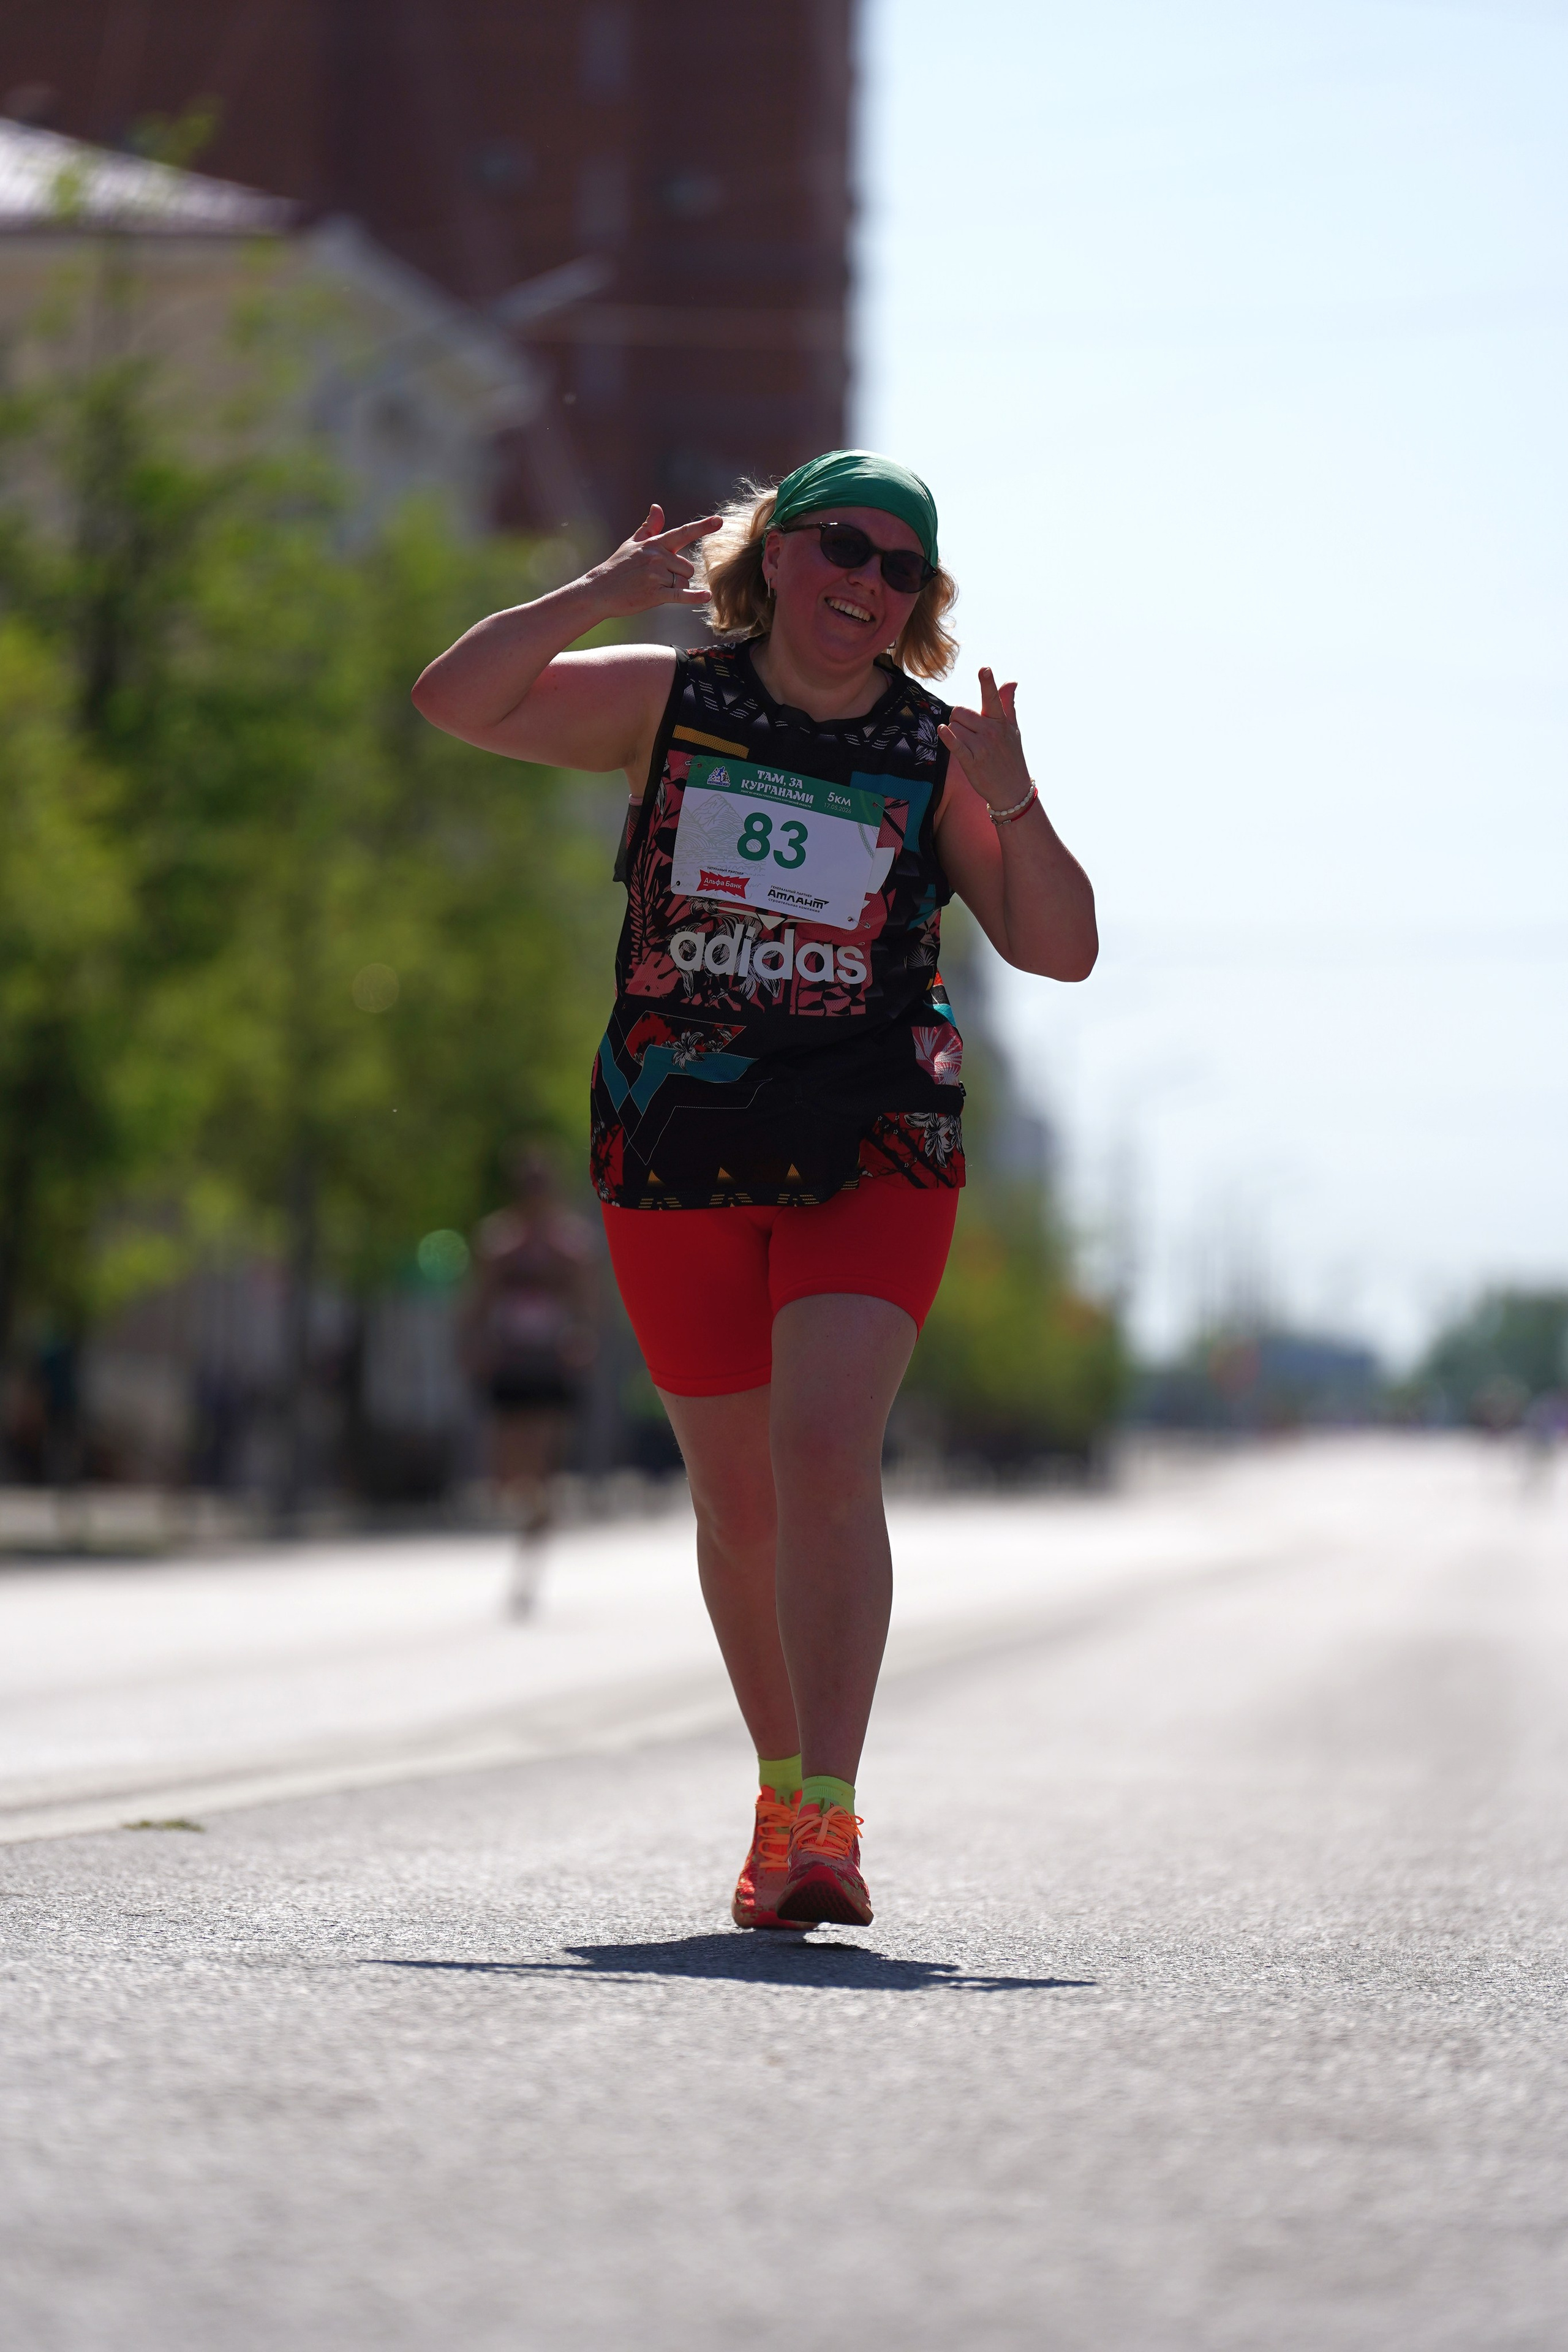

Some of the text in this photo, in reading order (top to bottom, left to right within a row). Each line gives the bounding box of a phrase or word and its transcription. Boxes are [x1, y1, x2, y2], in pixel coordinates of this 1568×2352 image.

[757, 770, 803, 789] ТАМ, ЗА
[741, 779, 814, 804] КУРГАНАМИ
[824, 802, 851, 813] 17.05.2026
[737, 812, 809, 869] 83
[703, 878, 742, 889] Альфа Банк
[771, 885, 796, 894] ГЕНЕРАЛЬНЫЙ
[768, 898, 798, 908] строительная
[669, 924, 867, 984] adidas
